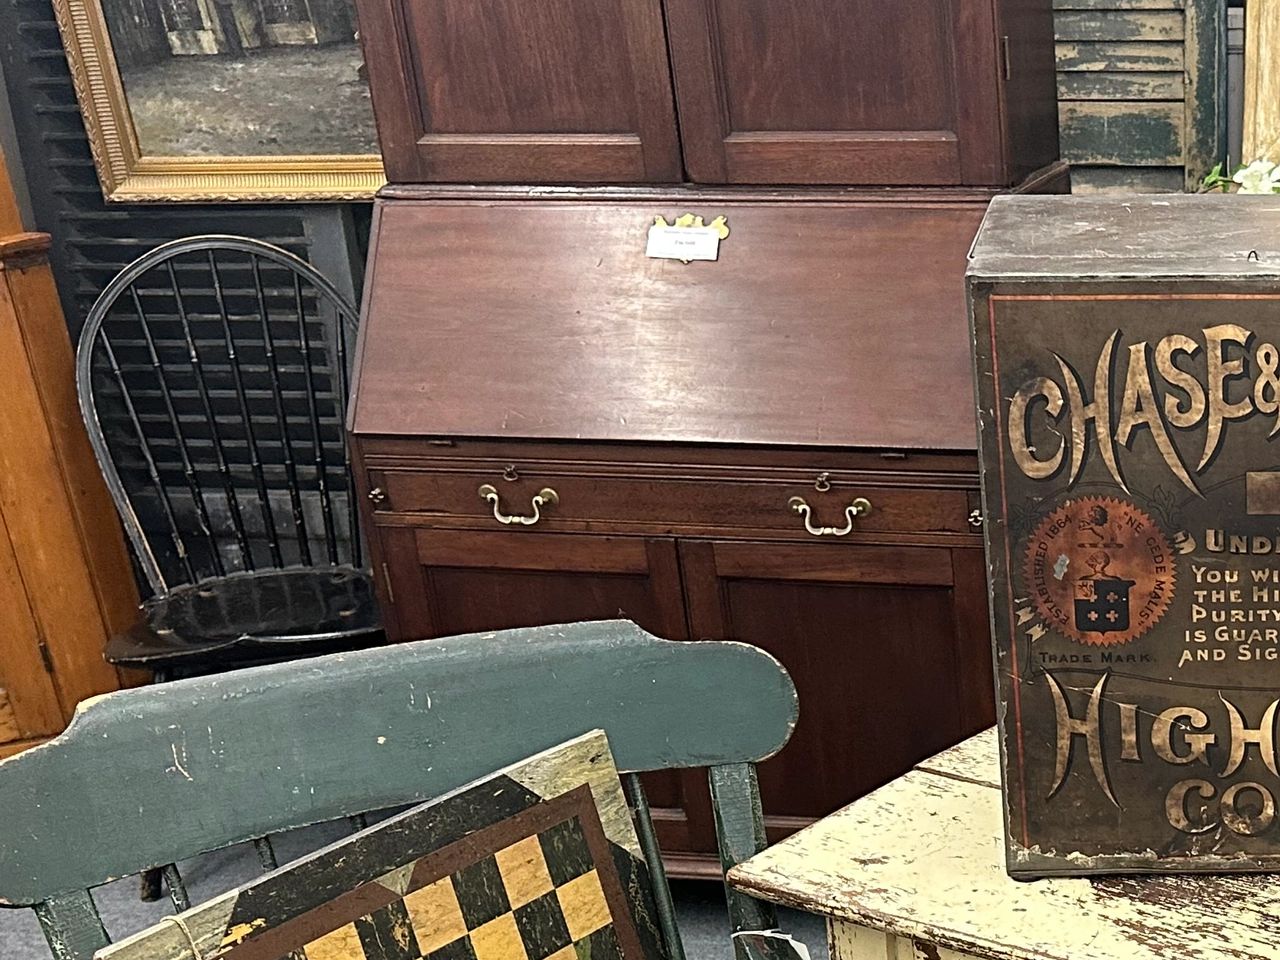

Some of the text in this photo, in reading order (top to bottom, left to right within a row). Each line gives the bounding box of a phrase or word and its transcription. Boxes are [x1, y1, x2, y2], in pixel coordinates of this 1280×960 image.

[1008, 323, 1254, 499] CHASE
[1033, 541, 1070, 625] ESTABLISHED
[1191, 564, 1240, 584] YOU
[1193, 589, 1243, 603] THE
[1184, 630, 1208, 642] IS
[1039, 651, 1093, 664] TRADE
[1177, 648, 1227, 668] AND
